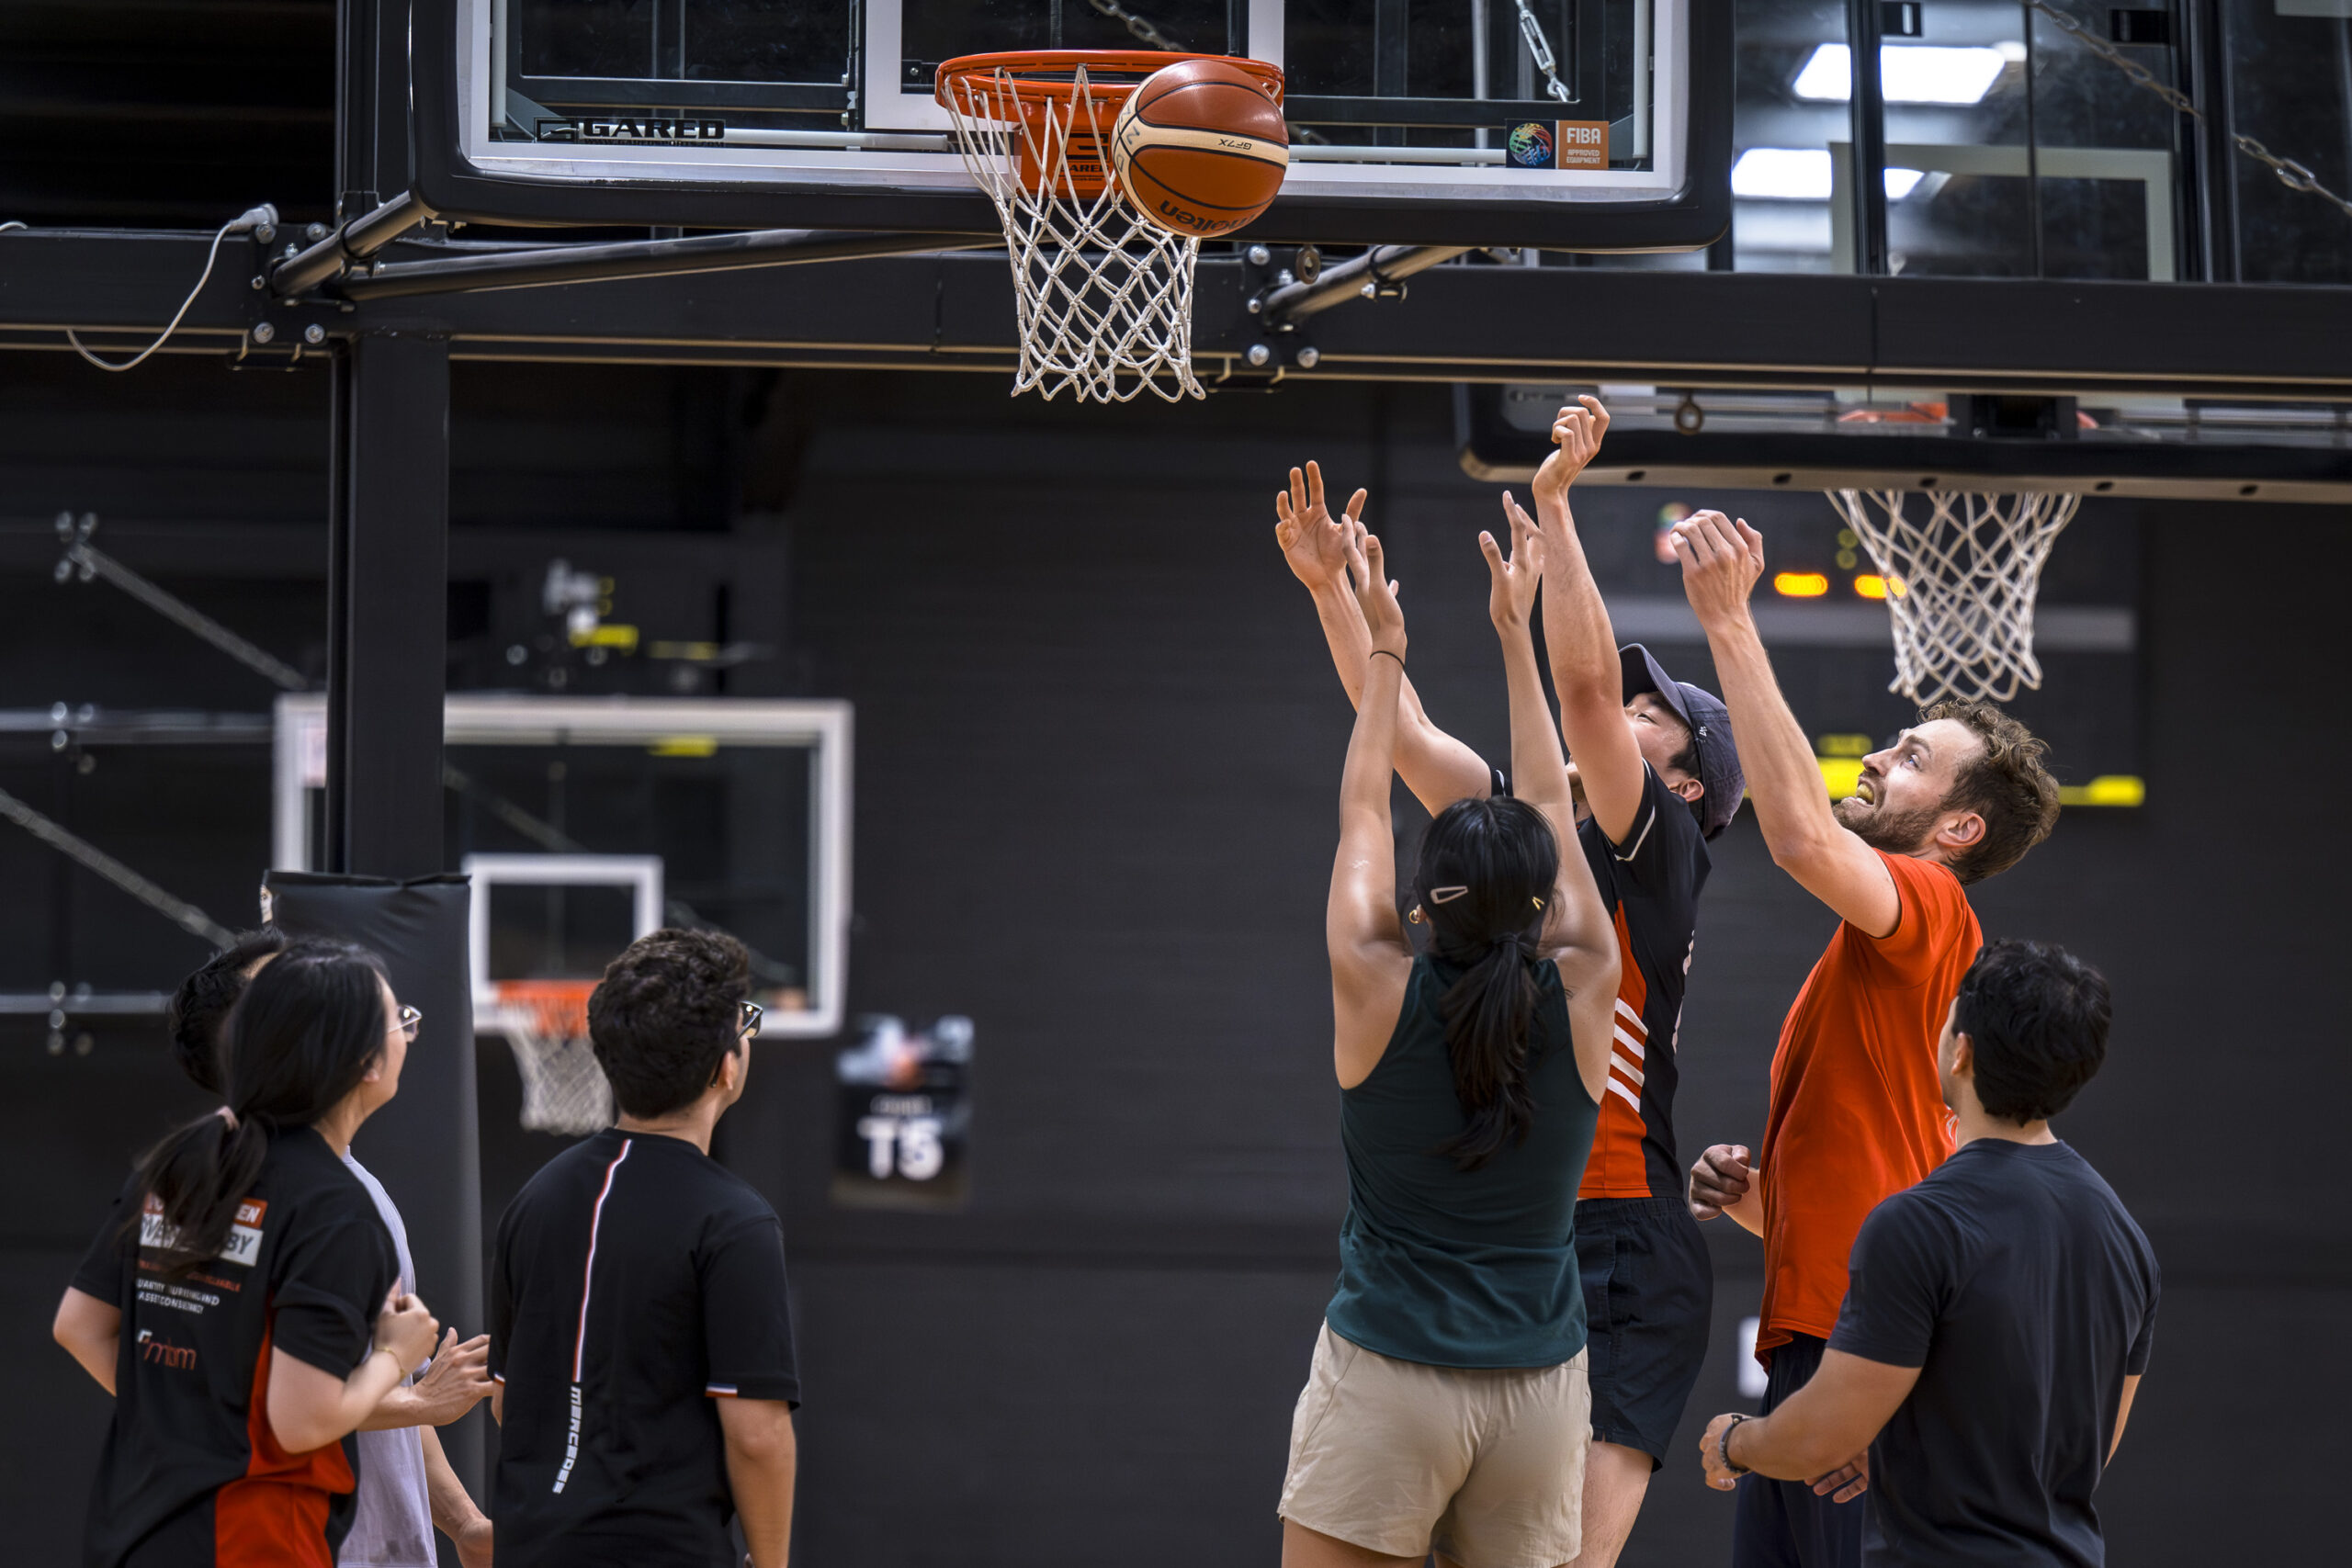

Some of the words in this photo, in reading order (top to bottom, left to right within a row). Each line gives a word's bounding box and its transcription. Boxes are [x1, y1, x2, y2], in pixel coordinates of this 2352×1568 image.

[582, 118, 725, 140] GARED
[1566, 128, 1601, 144] FIBA
[1218, 139, 1252, 151] GF7X
[1566, 156, 1601, 164] EQUIPMENT
[1159, 199, 1256, 232] molten
[552, 1385, 582, 1495] MERCEDES
